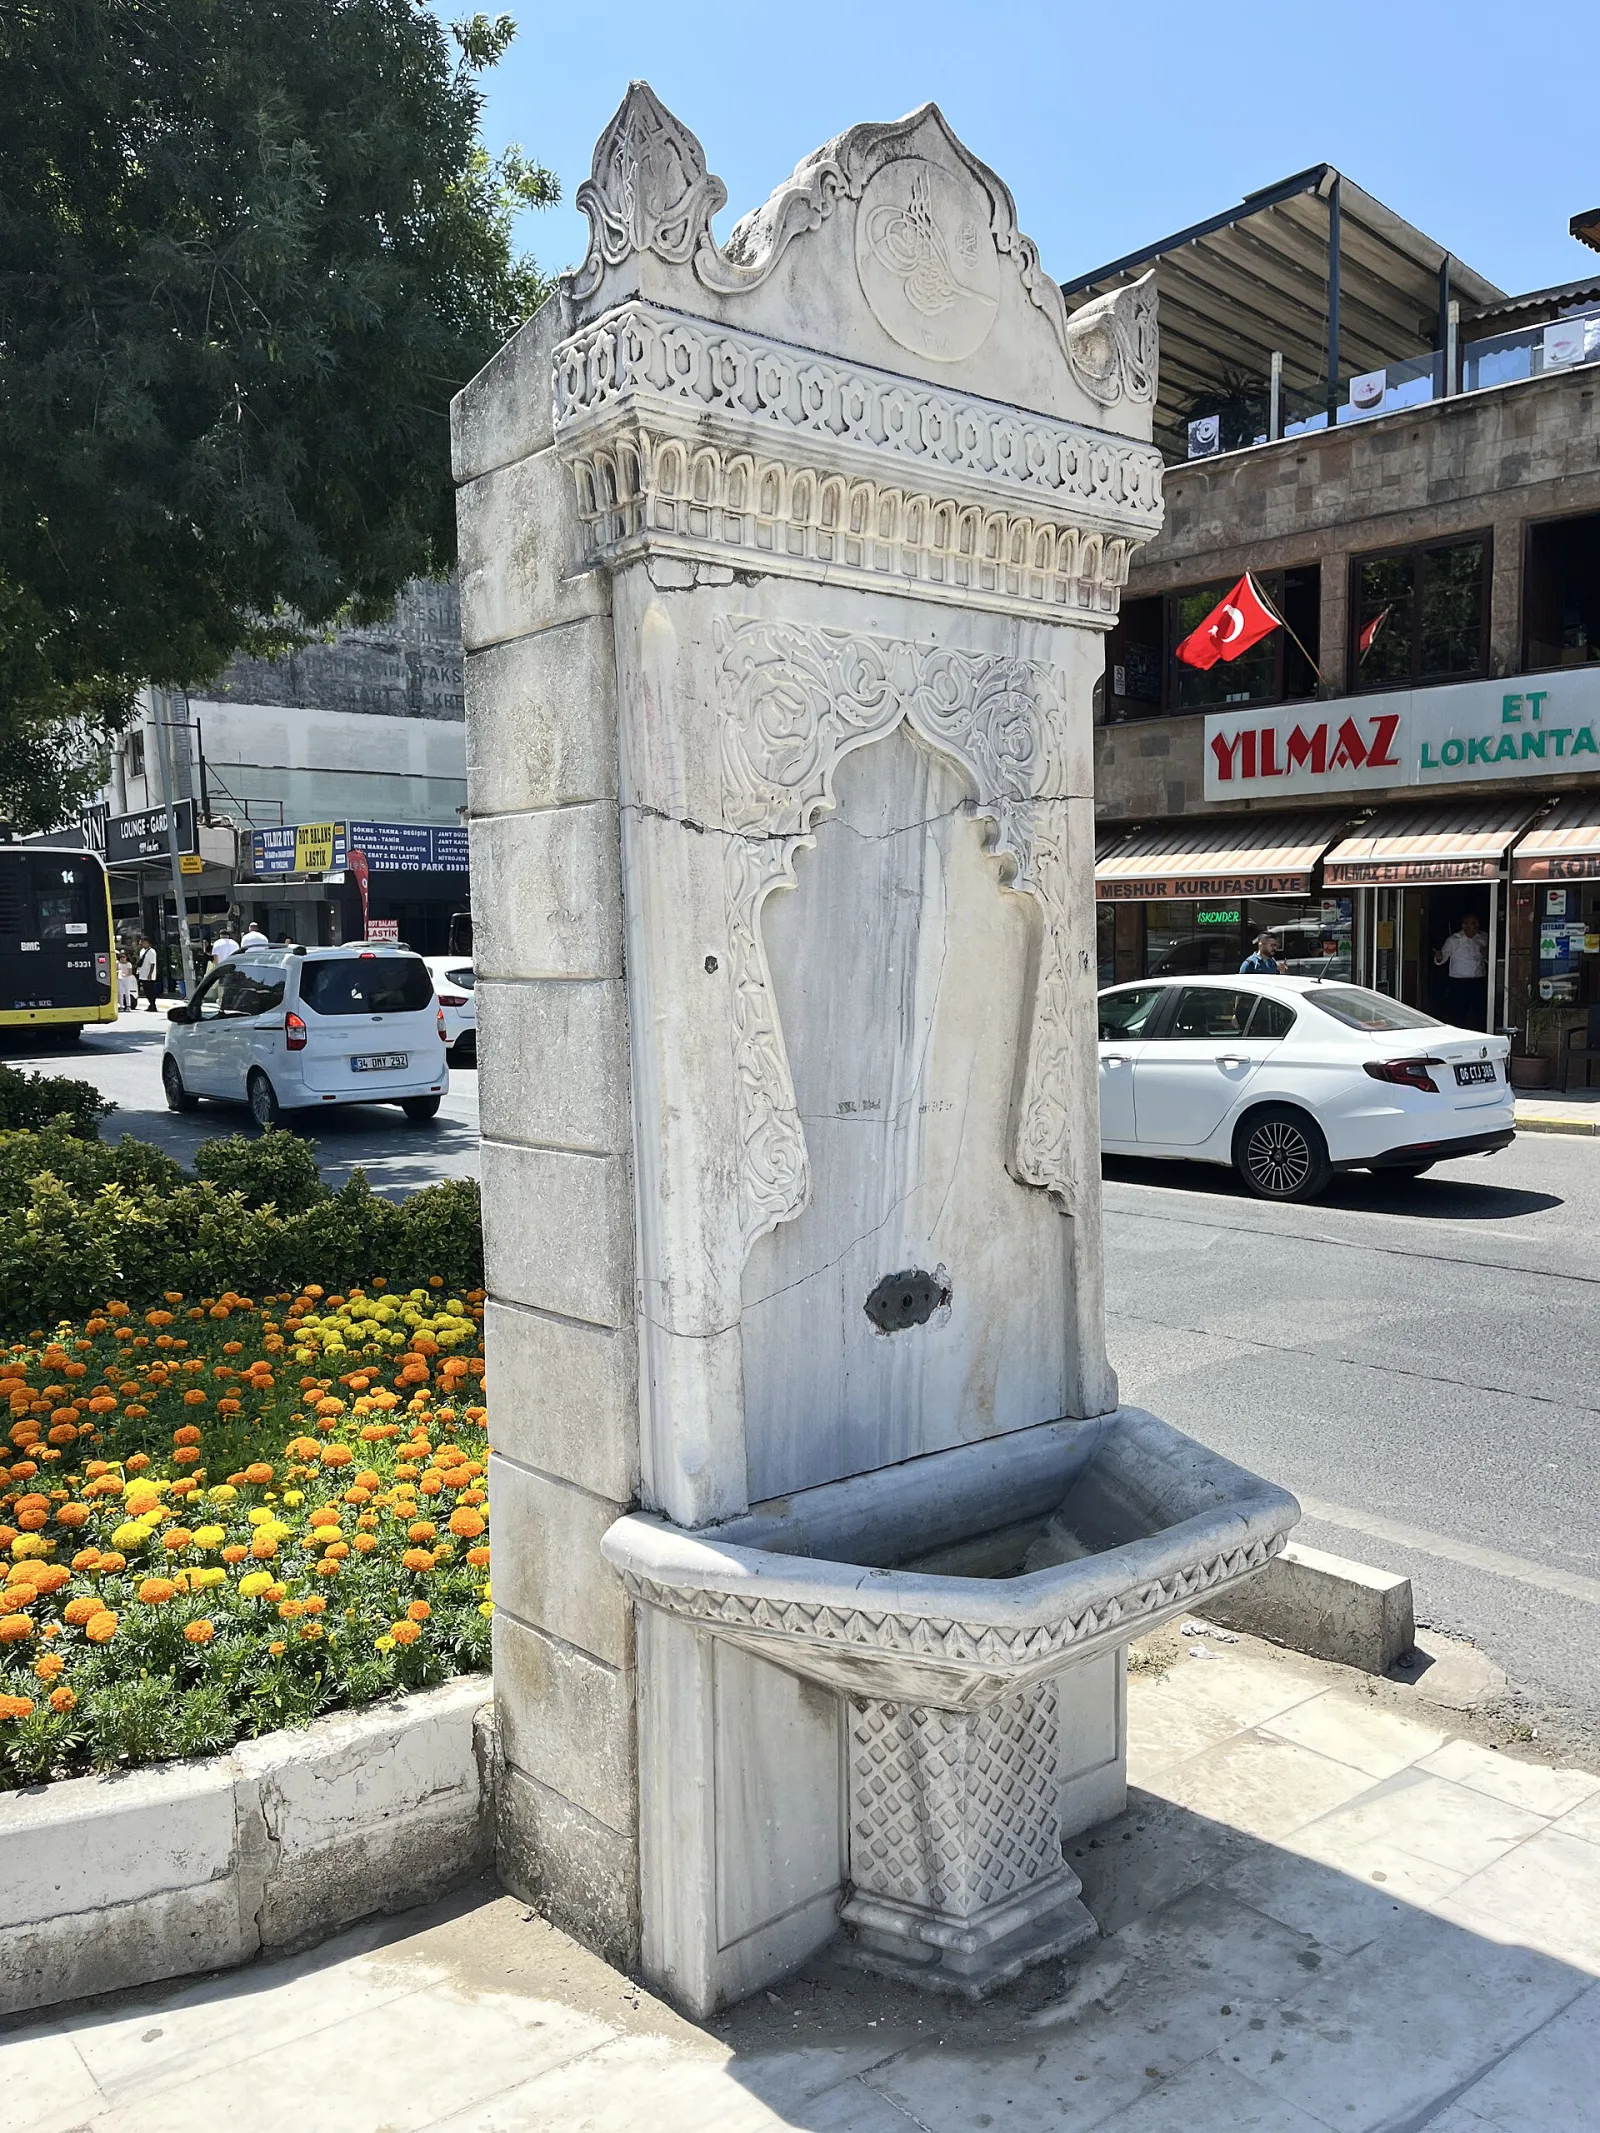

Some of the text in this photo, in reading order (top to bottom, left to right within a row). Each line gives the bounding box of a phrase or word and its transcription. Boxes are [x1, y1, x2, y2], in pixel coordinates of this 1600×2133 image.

[1501, 691, 1549, 724] ET
[1210, 713, 1401, 781] YILMAZ
[120, 811, 177, 839] LOUNGE GARDN
[263, 830, 294, 848] YILDIZ OTO
[310, 826, 331, 844] BALANS
[305, 847, 326, 867] LASTİK
[406, 845, 427, 853] LASTİK
[401, 862, 444, 871] OTO PARK
[1332, 864, 1379, 882] YILMAZ
[1101, 877, 1301, 897] MEŞHUR KURUFASÜLYE
[368, 929, 398, 938] LASTİK
[20, 941, 40, 951] BMC
[358, 1059, 368, 1068] 34
